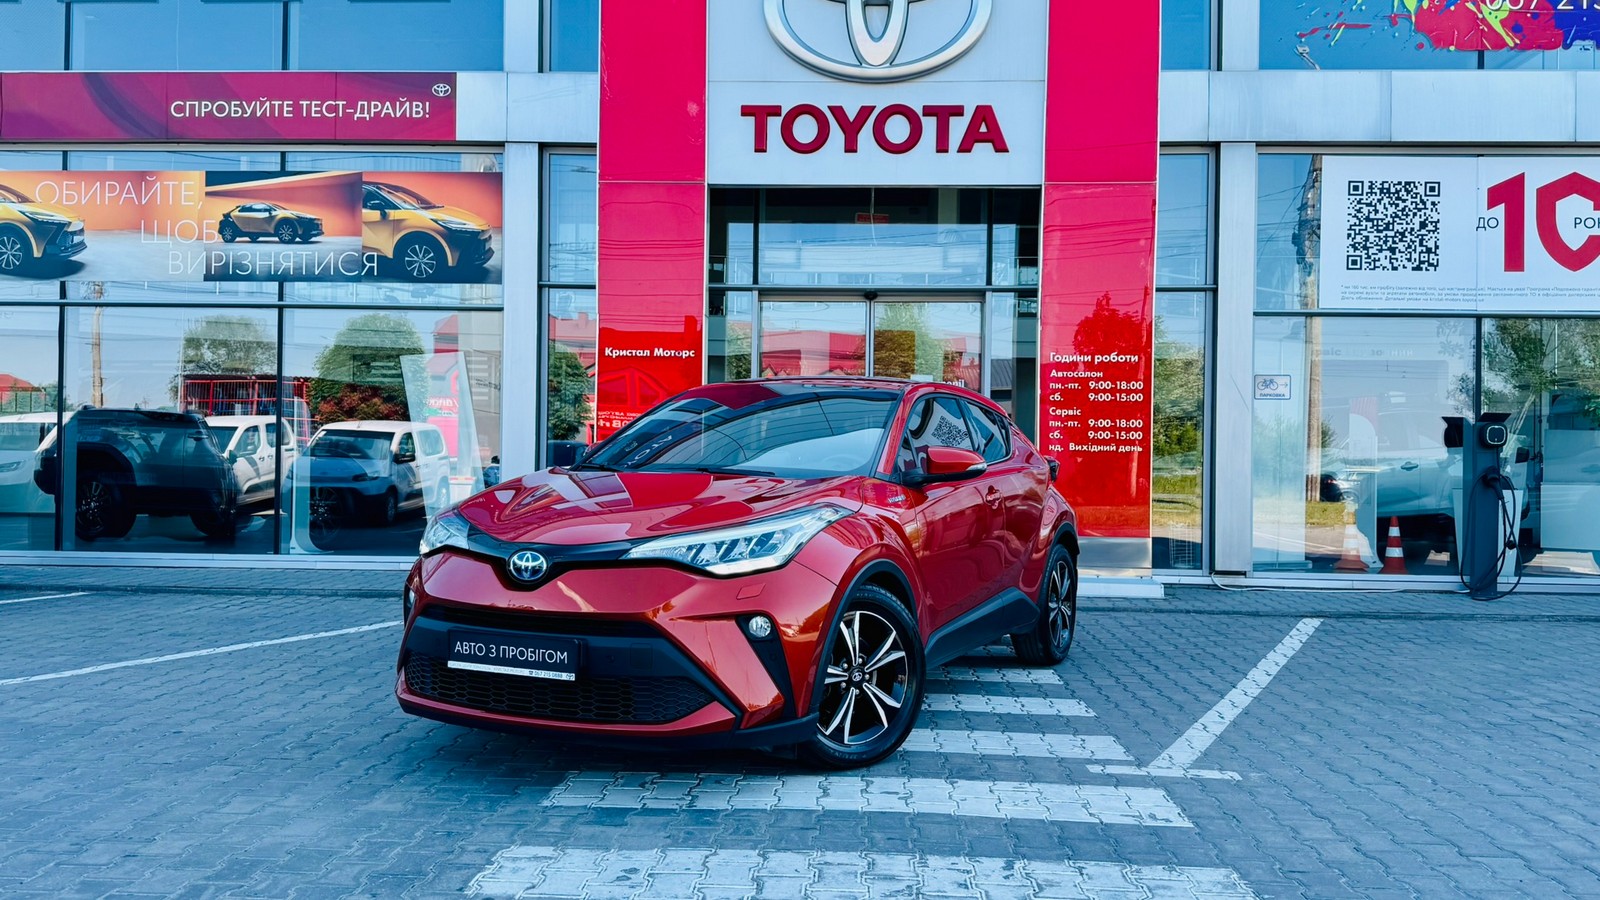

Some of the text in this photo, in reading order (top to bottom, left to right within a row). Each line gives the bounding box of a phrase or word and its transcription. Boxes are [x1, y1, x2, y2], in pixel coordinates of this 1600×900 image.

[170, 97, 430, 121] СПРОБУЙТЕ ТЕСТ-ДРАЙВ!
[740, 103, 1009, 155] TOYOTA
[35, 175, 203, 210] ОБИРАЙТЕ,
[1476, 217, 1499, 231] ДО
[141, 219, 218, 248] ЩОБ
[168, 250, 378, 276] ВИРІЗНЯТИСЯ
[605, 347, 696, 359] Кристал Моторс
[1050, 352, 1138, 365] Години роботи
[1050, 369, 1103, 378] Автосалон
[1088, 381, 1144, 390] 9:00-18:00
[1049, 392, 1144, 402] сб. 9:00-15:00
[1049, 406, 1082, 418] Сервіс
[1088, 418, 1143, 428] 9:00-18:00
[1049, 430, 1143, 440] сб. 9:00-15:00
[1048, 444, 1064, 452] нд.
[1069, 442, 1116, 452] Вихідний
[454, 641, 486, 656] АВТО
[500, 646, 568, 664] ПРОБІГОМ
